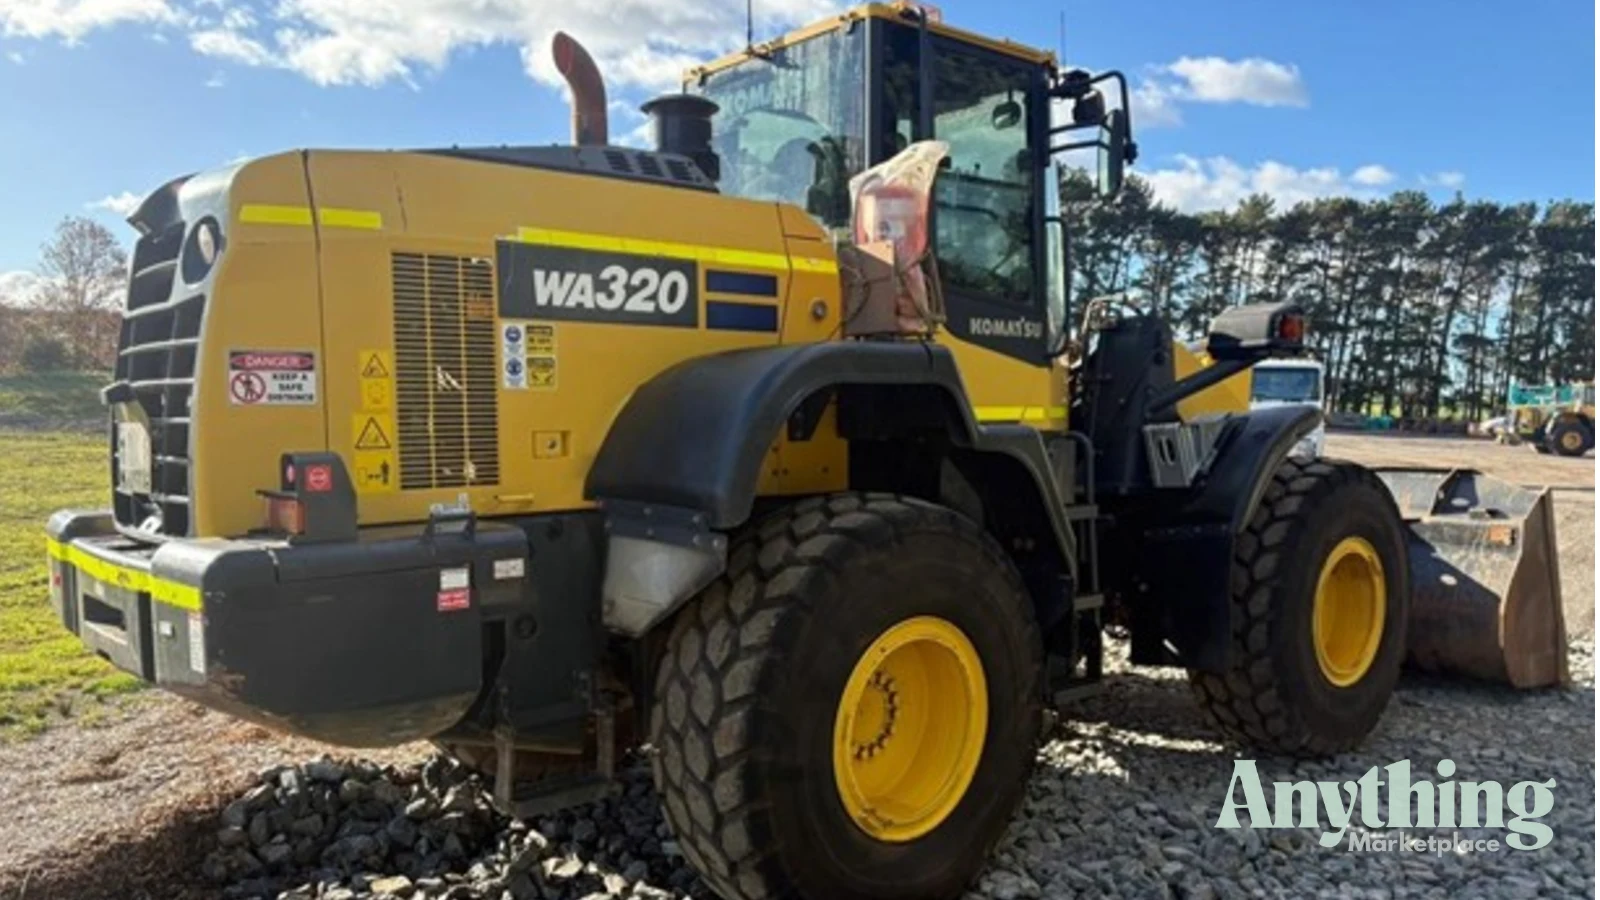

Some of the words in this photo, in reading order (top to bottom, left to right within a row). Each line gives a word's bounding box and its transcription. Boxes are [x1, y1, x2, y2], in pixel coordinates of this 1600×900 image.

[533, 265, 689, 314] WA320
[969, 316, 1043, 337] KOMATSU
[245, 355, 301, 367] DANGER
[272, 373, 298, 381] KEEP
[278, 383, 303, 391] SAFE
